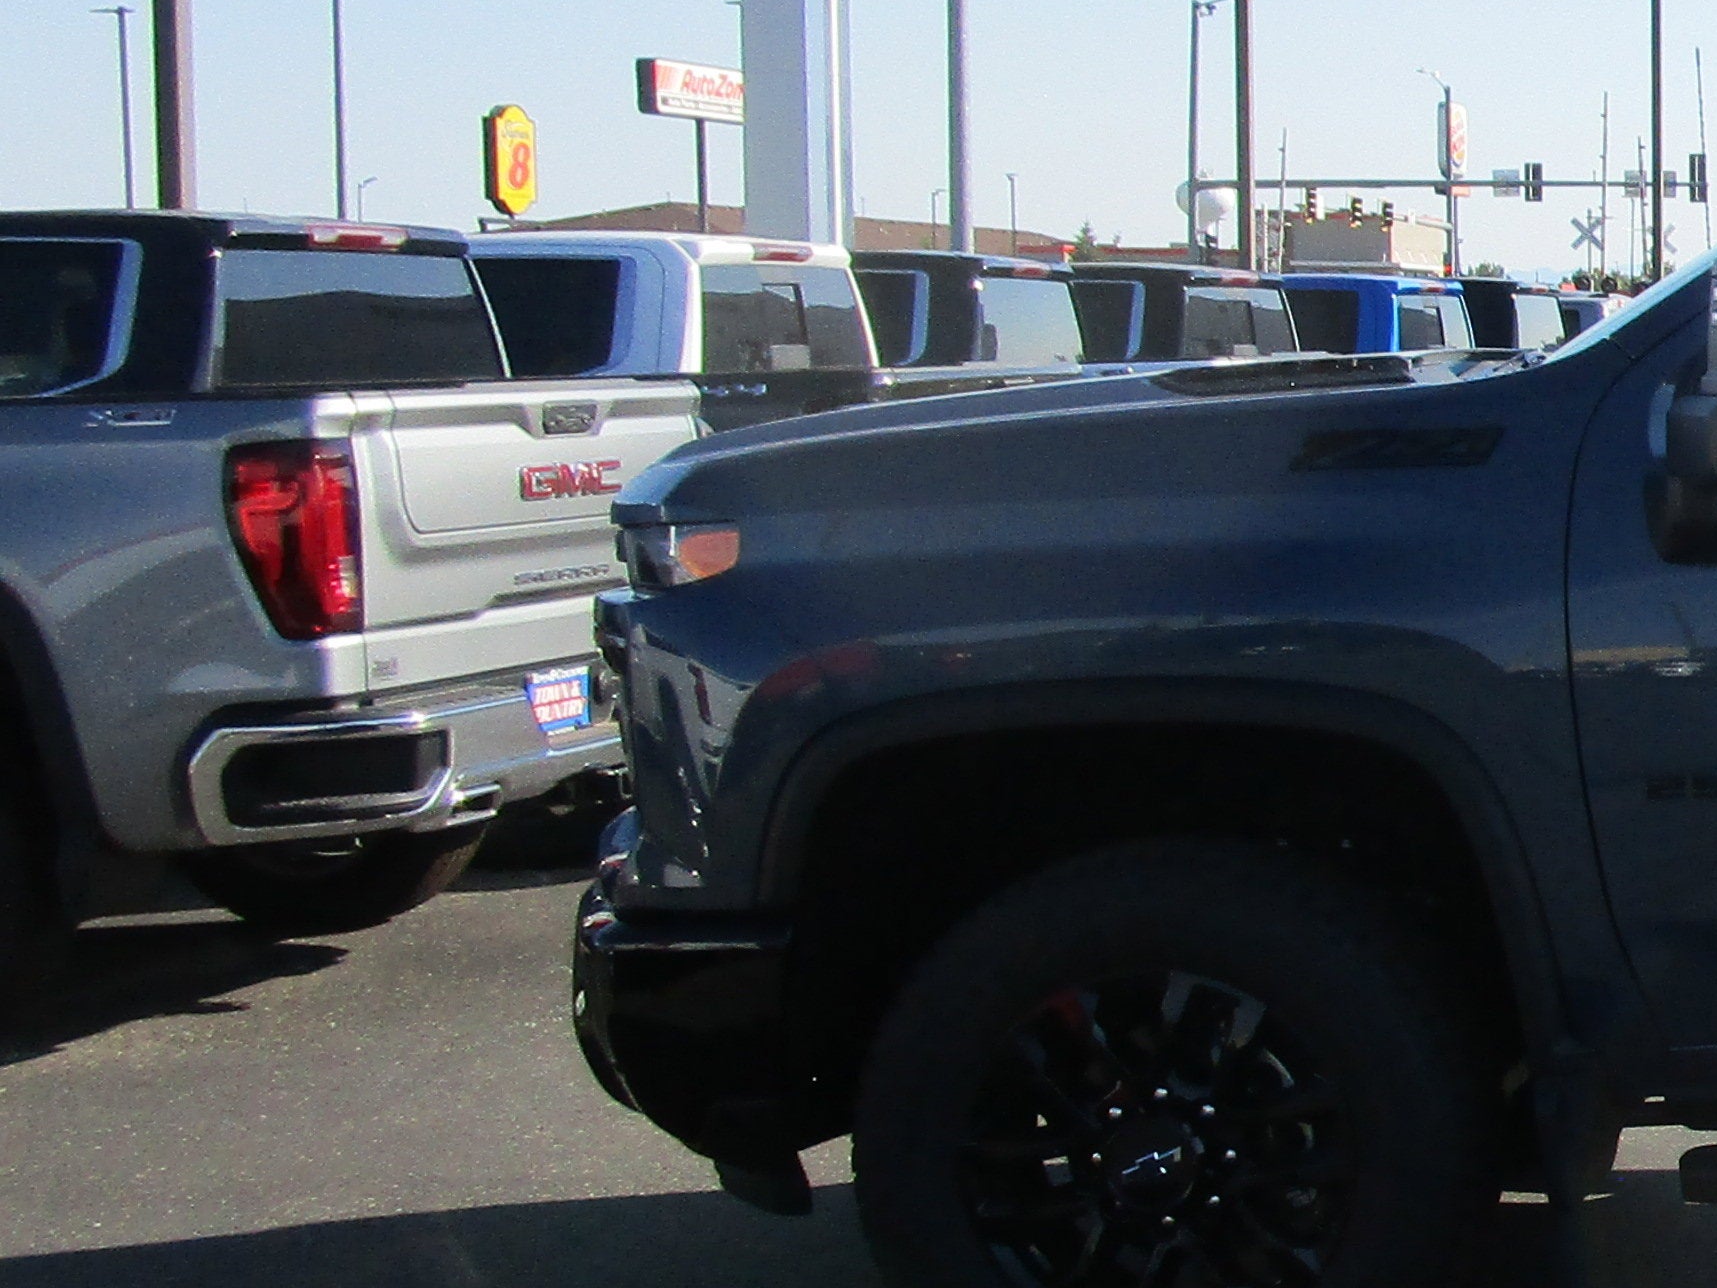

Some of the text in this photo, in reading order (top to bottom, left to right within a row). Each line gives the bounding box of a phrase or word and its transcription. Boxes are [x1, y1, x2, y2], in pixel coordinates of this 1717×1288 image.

[681, 69, 746, 100] AutoZon
[508, 142, 531, 189] 8
[519, 460, 623, 502] GMC
